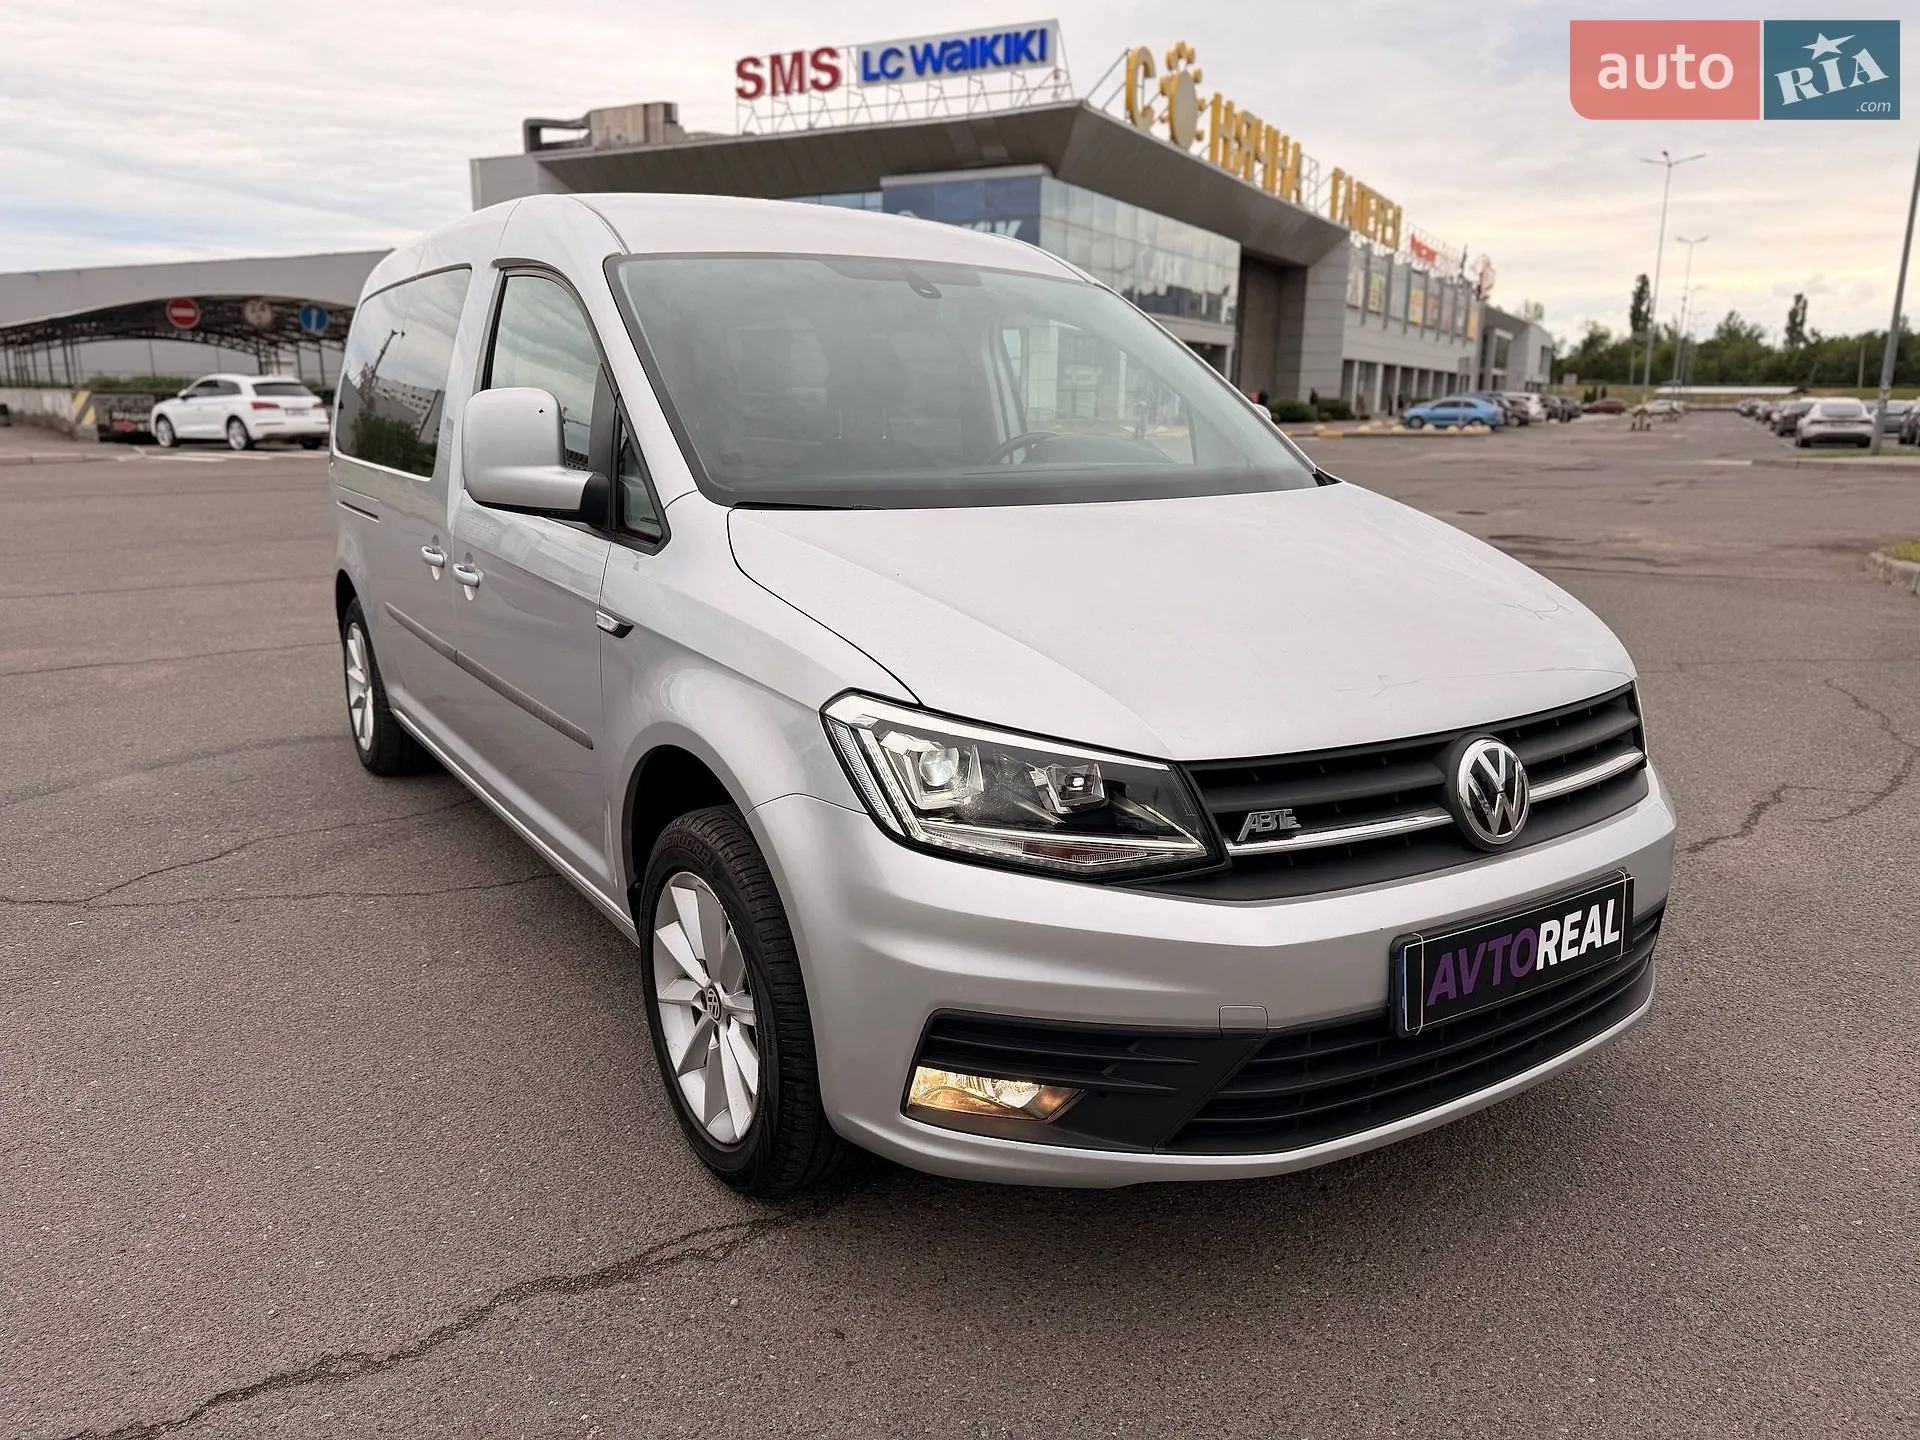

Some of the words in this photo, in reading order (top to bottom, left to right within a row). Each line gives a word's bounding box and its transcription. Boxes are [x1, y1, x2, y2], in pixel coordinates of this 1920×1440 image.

[735, 46, 842, 101] SMS
[861, 47, 905, 82] LC
[1426, 898, 1621, 1007] AVTOREAL
